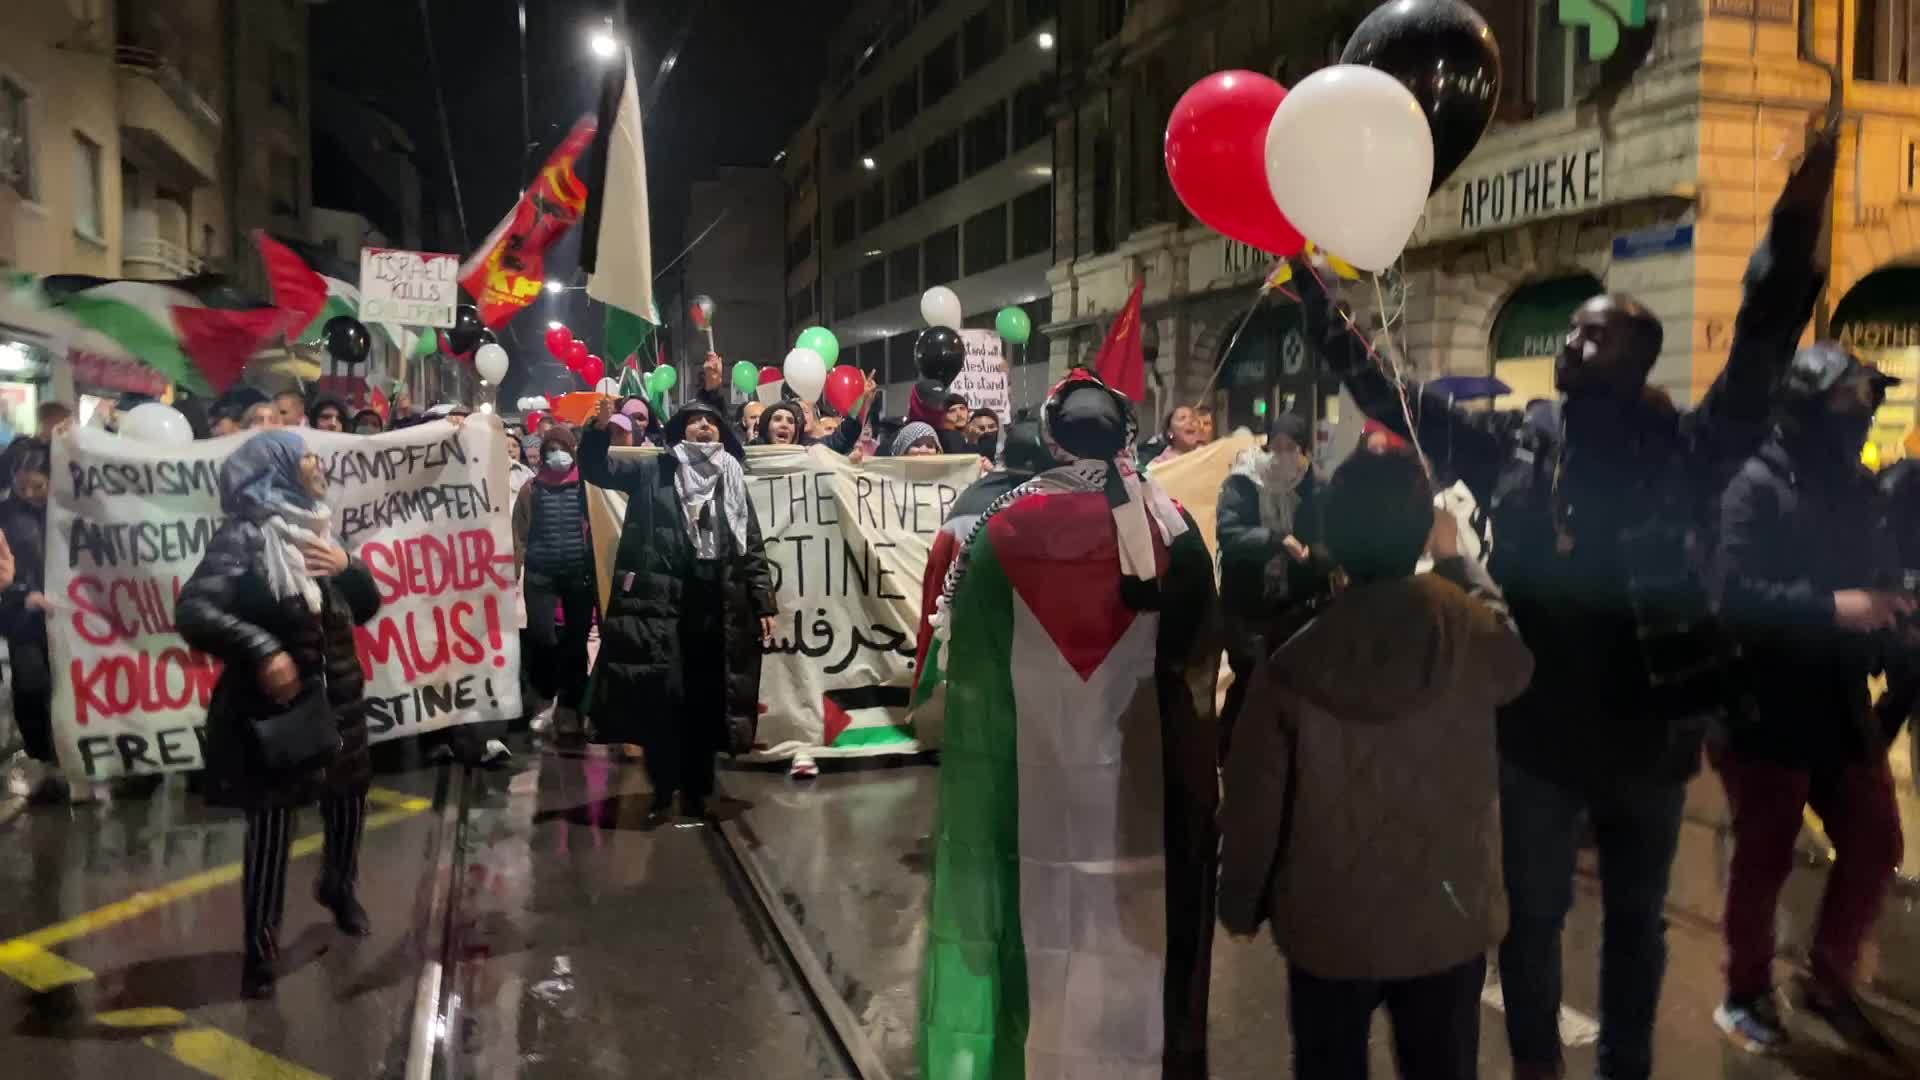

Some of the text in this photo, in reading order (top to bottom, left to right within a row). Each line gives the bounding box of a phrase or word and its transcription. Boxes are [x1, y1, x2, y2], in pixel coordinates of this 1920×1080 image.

[1461, 148, 1600, 229] APOTHEKE
[375, 254, 450, 282] ISRAEL
[757, 471, 839, 528] THE
[353, 594, 505, 683] MUS!
